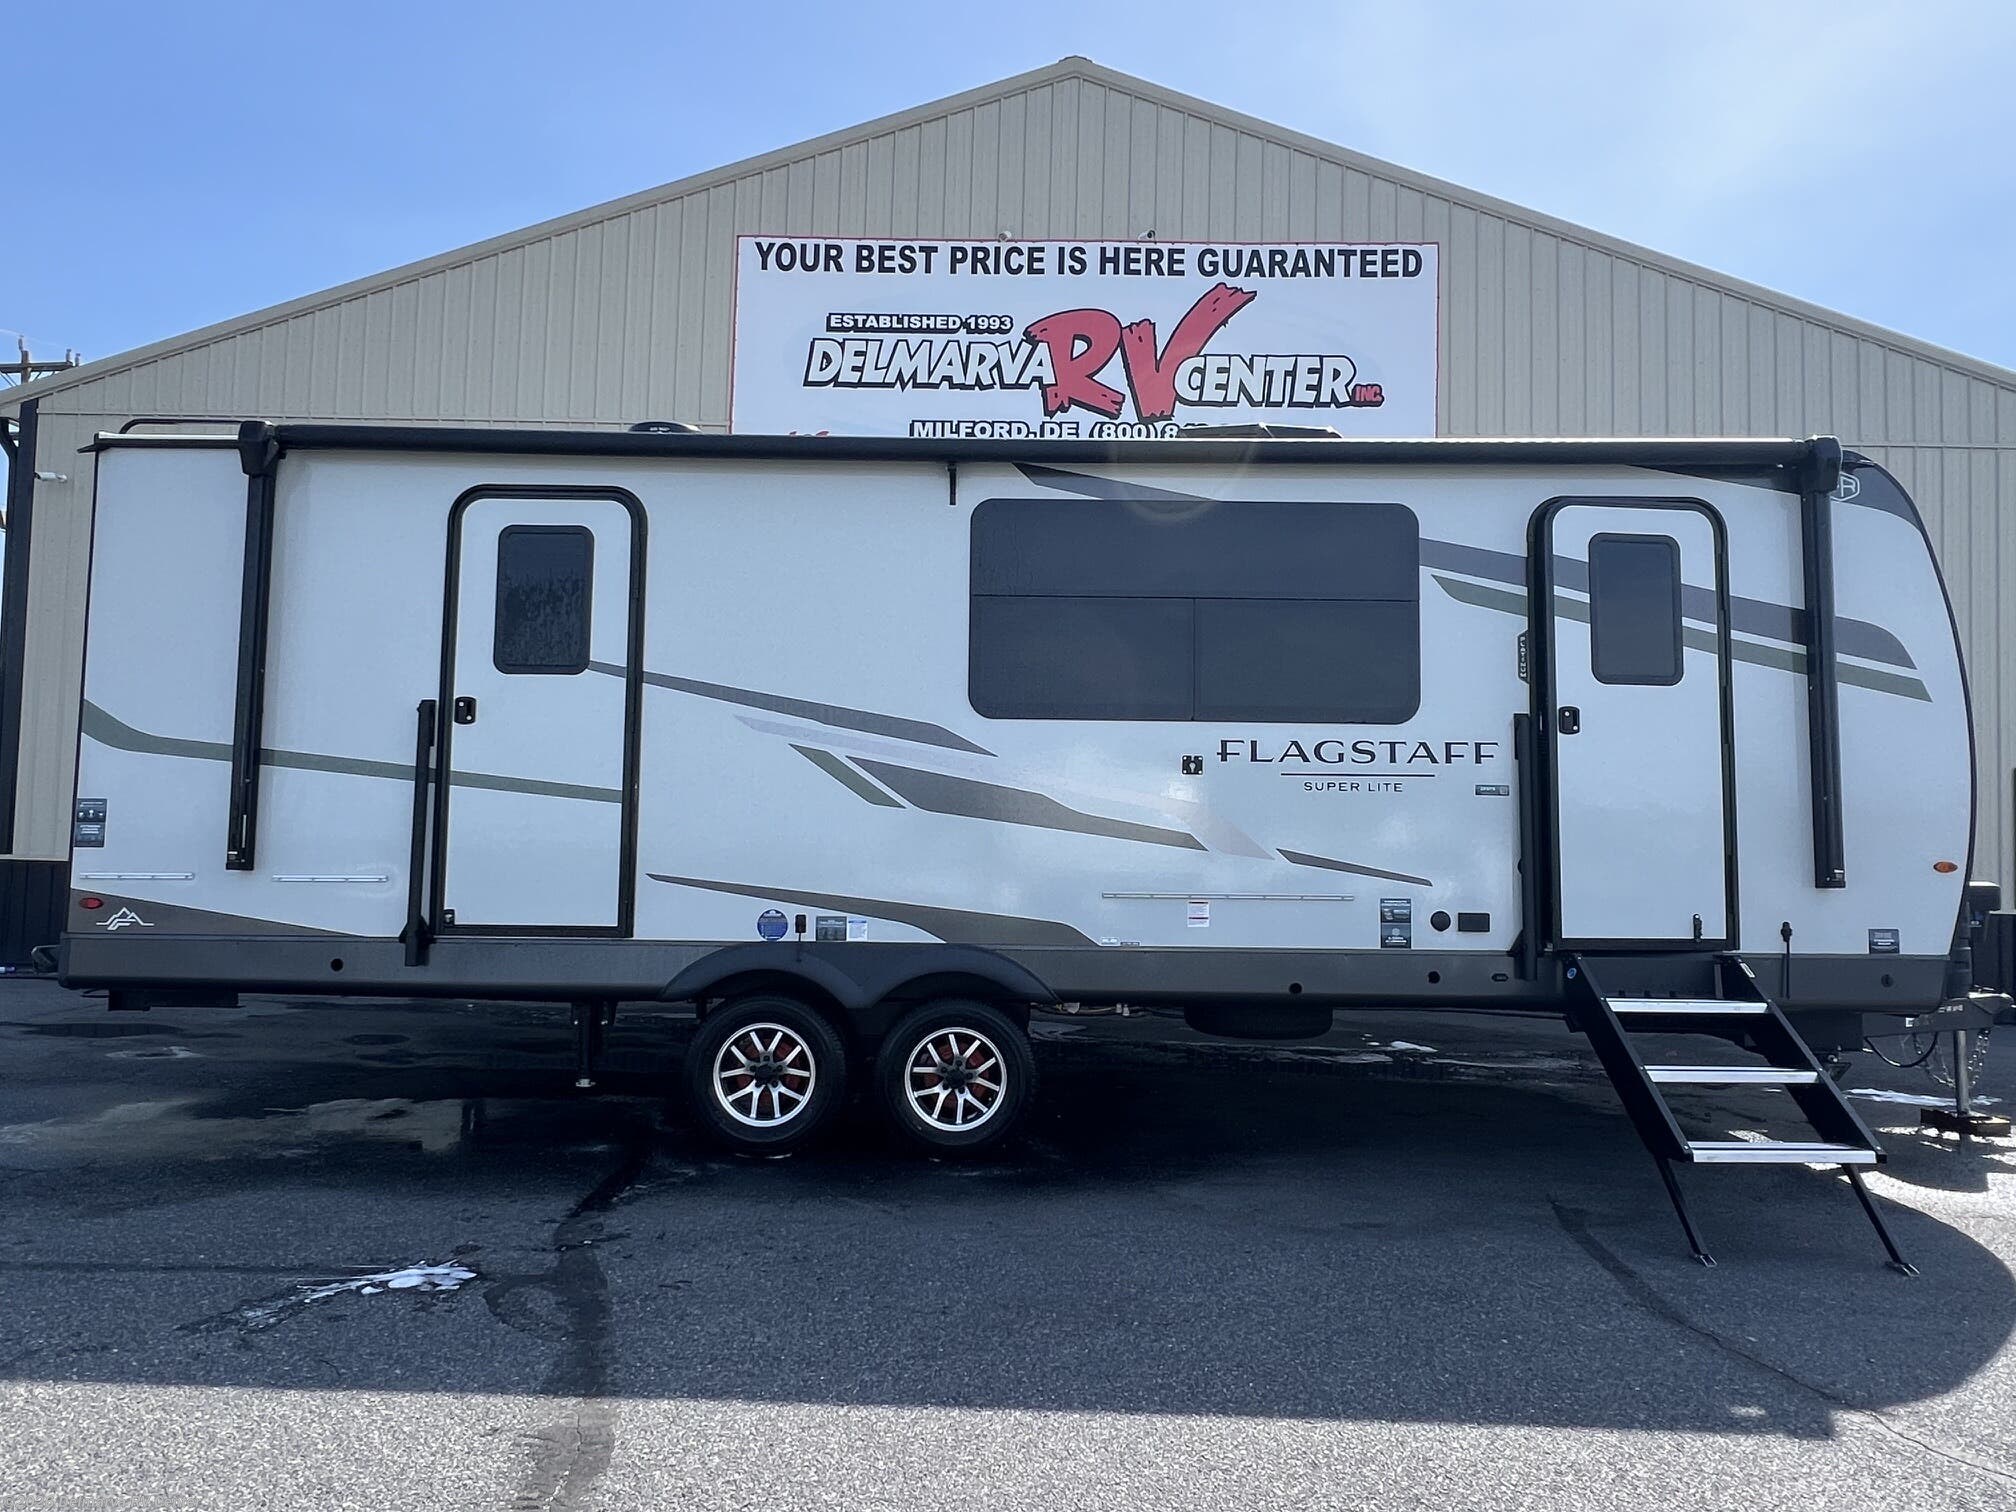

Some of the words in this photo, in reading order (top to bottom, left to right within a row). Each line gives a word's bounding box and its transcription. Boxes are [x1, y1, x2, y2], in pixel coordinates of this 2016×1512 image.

[755, 242, 844, 273] YOUR
[855, 246, 938, 274] BEST
[950, 246, 1045, 275] PRICE
[1058, 247, 1087, 275] IS
[1100, 247, 1185, 276] HERE
[1198, 248, 1423, 278] GUARANTEED
[828, 314, 961, 331] ESTABLISHED
[965, 316, 1012, 331] 1993
[803, 338, 1058, 391] DELMARVA
[1023, 282, 1258, 421] RV
[1174, 354, 1356, 408] CENTER
[1040, 421, 1080, 439] DE
[1216, 739, 1499, 765] FLAGSTAFF
[1304, 781, 1361, 793] SUPER
[1368, 782, 1403, 793] LITE
